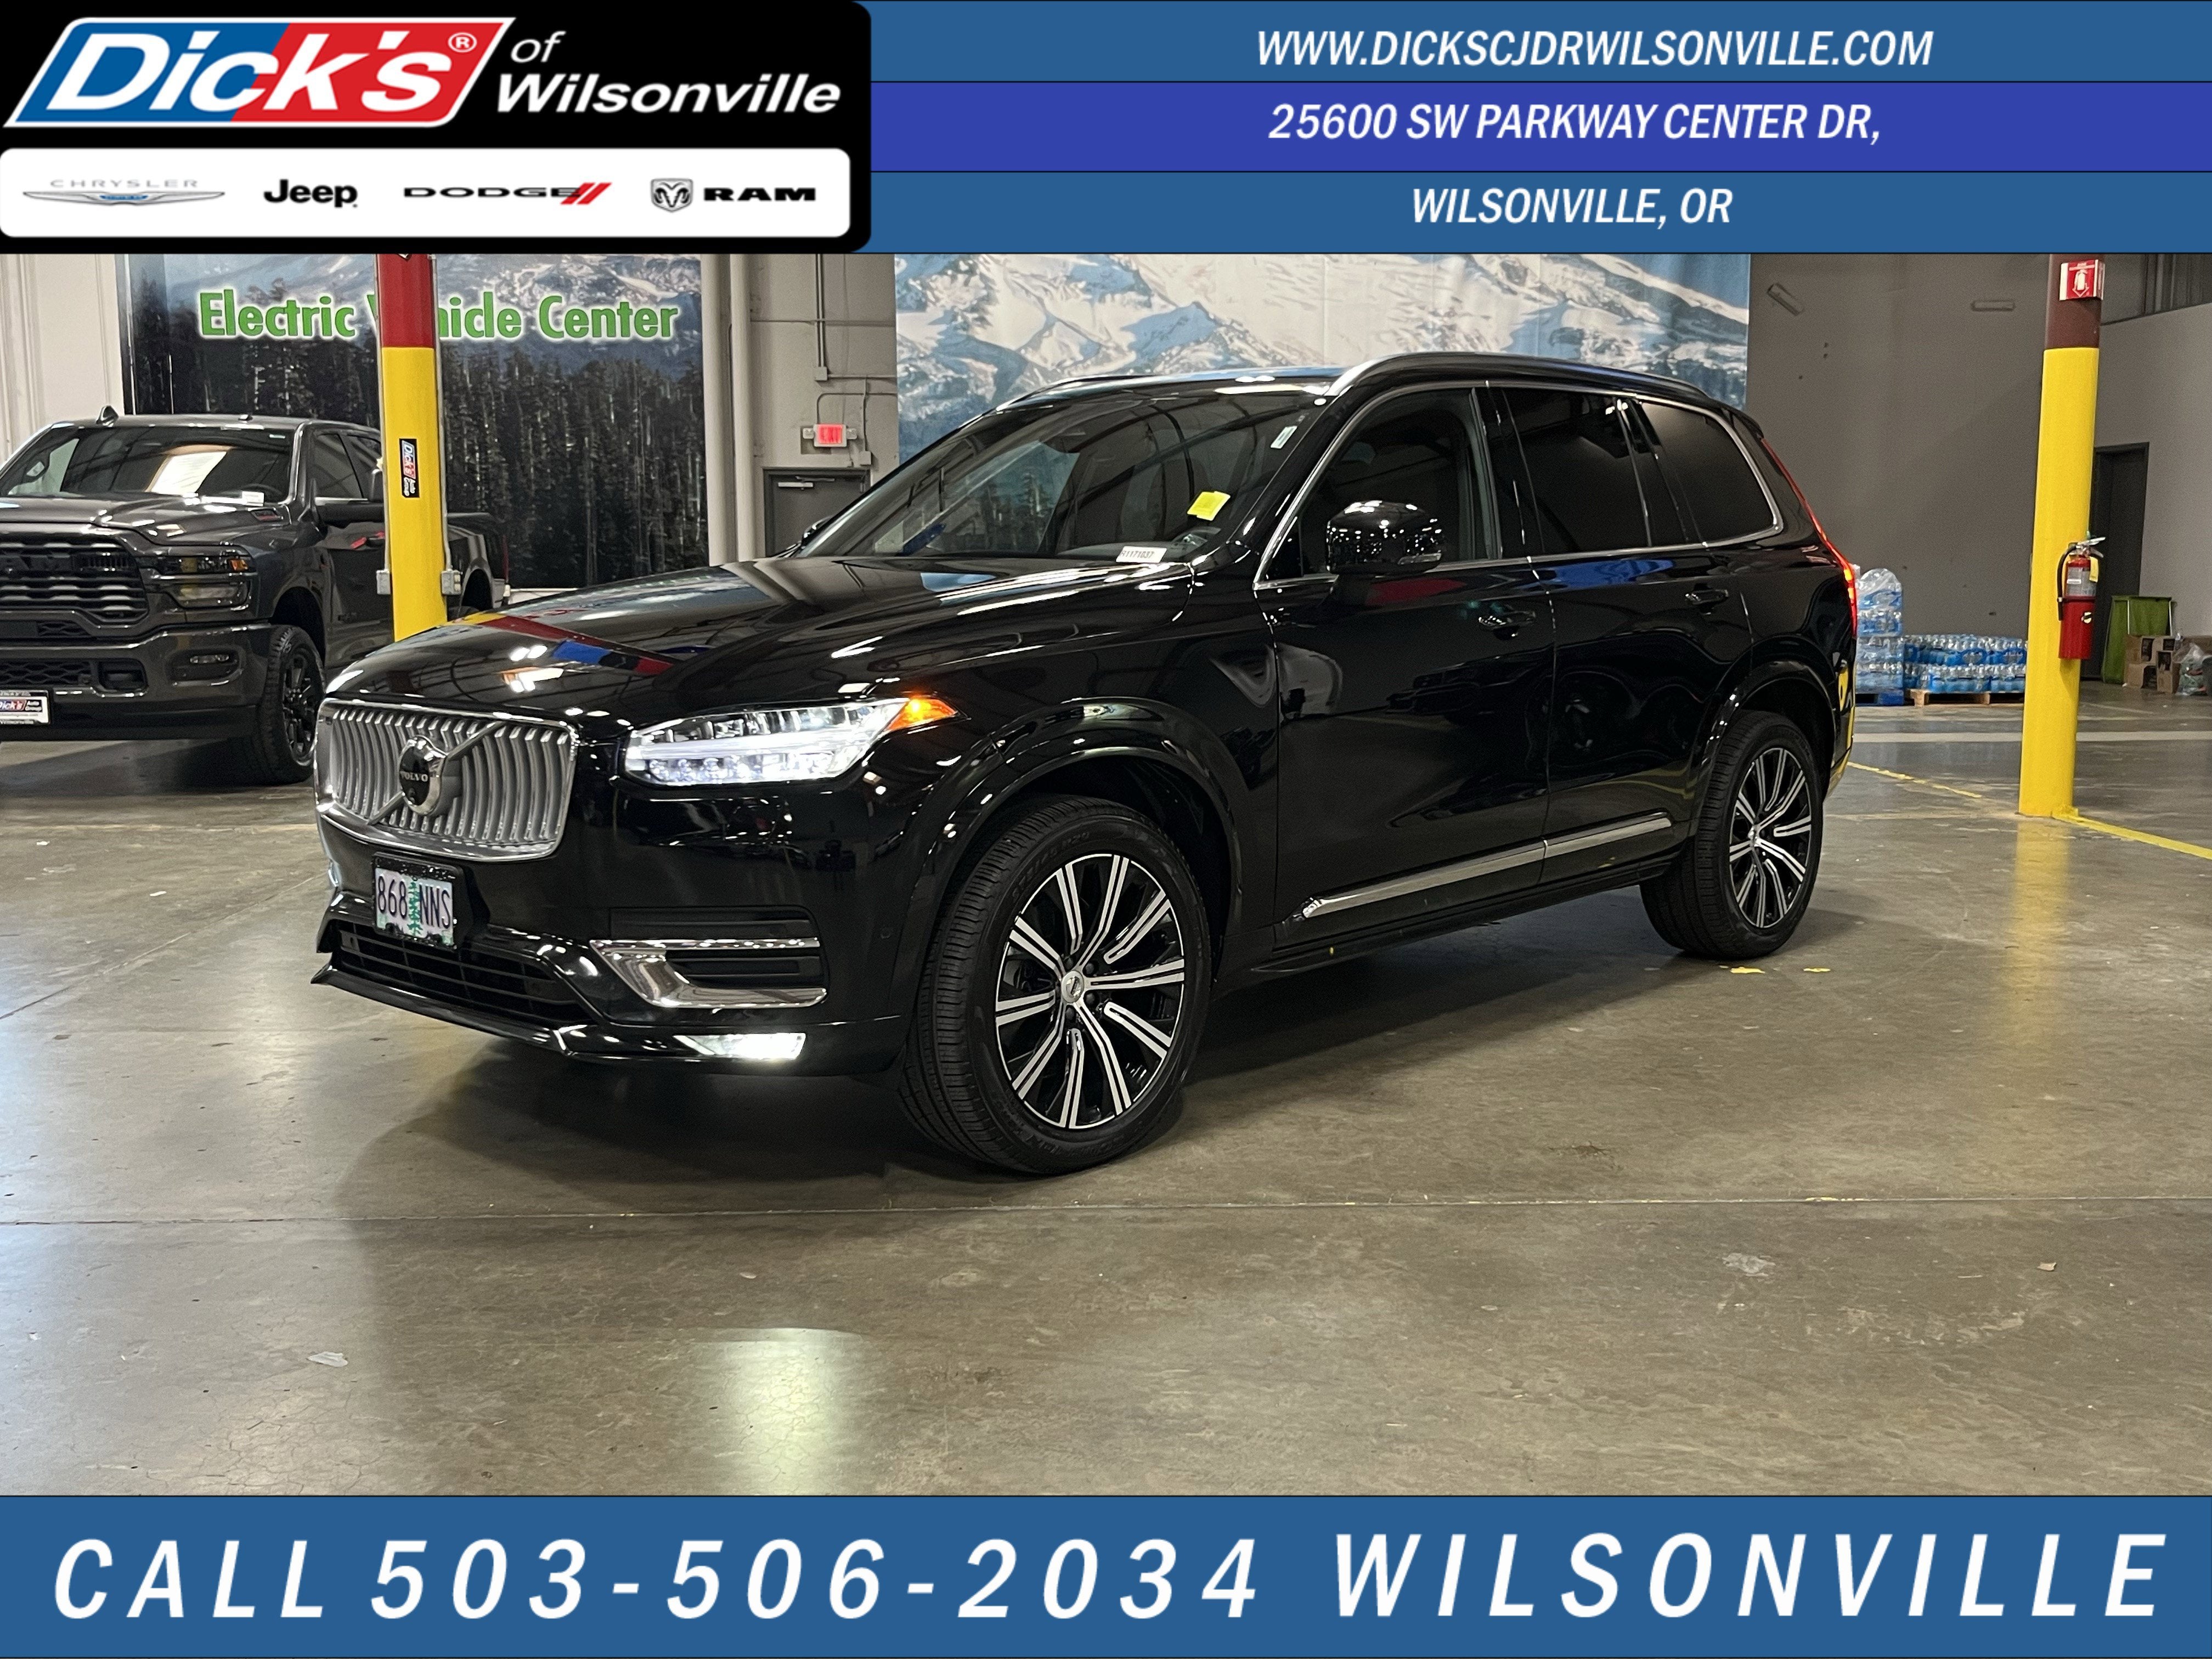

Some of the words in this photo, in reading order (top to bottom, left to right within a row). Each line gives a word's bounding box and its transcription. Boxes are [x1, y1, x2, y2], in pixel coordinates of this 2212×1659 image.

[200, 289, 356, 337] Electric
[538, 295, 678, 338] Center
[378, 876, 408, 919] 868
[419, 884, 451, 929] NNS
